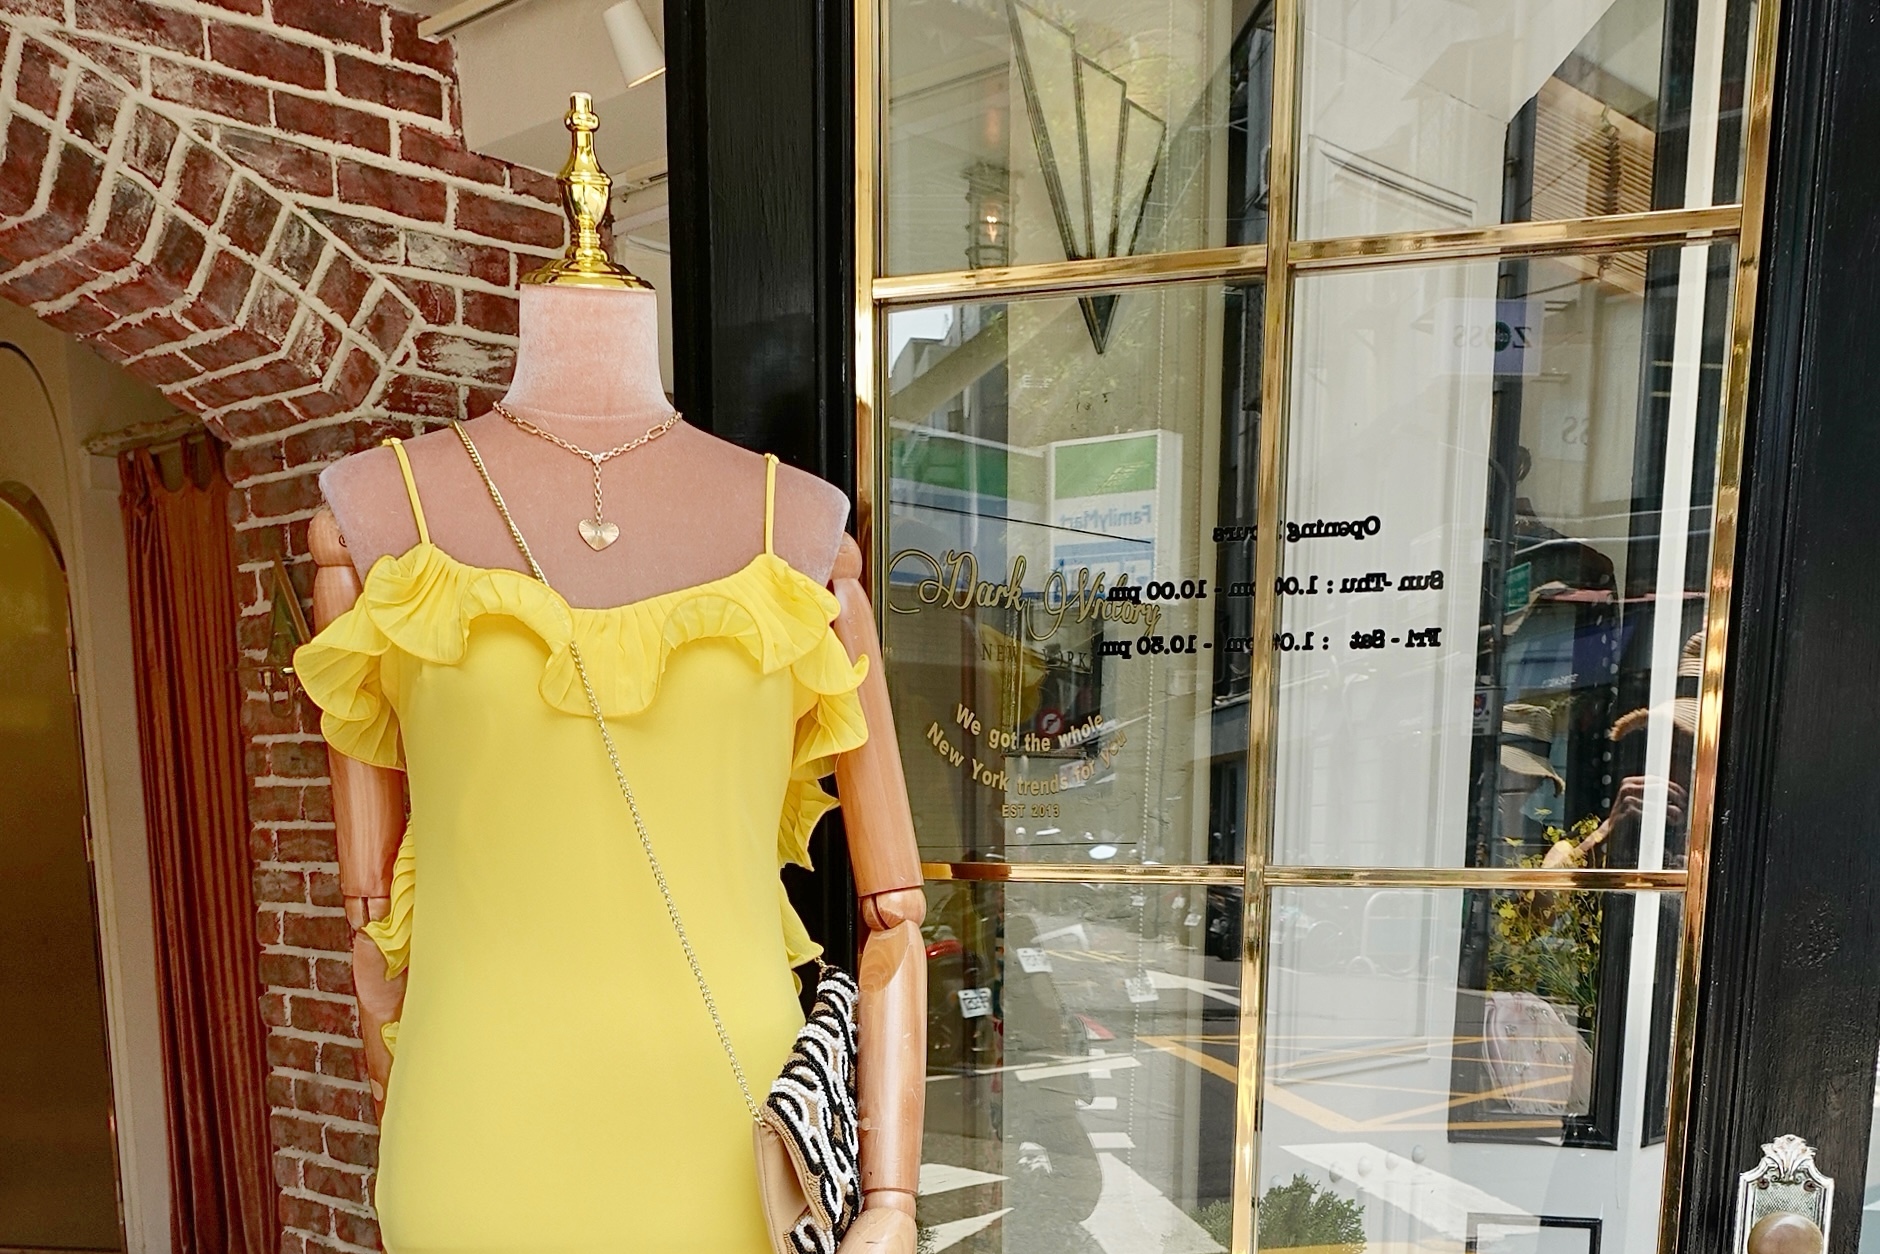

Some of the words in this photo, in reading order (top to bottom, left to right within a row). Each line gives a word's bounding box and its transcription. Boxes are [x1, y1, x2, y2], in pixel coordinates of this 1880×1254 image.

[889, 549, 1027, 613] Dark
[982, 642, 1017, 662] NEW
[956, 703, 982, 736] We
[989, 728, 1018, 750] got
[1024, 732, 1051, 752] the
[1058, 714, 1103, 749] whole
[926, 722, 965, 768] New
[970, 758, 1009, 792] York
[1017, 774, 1069, 796] trends
[1074, 761, 1096, 784] for
[1100, 730, 1128, 769] you
[1001, 804, 1025, 818] EST
[1031, 803, 1061, 819] 2013
